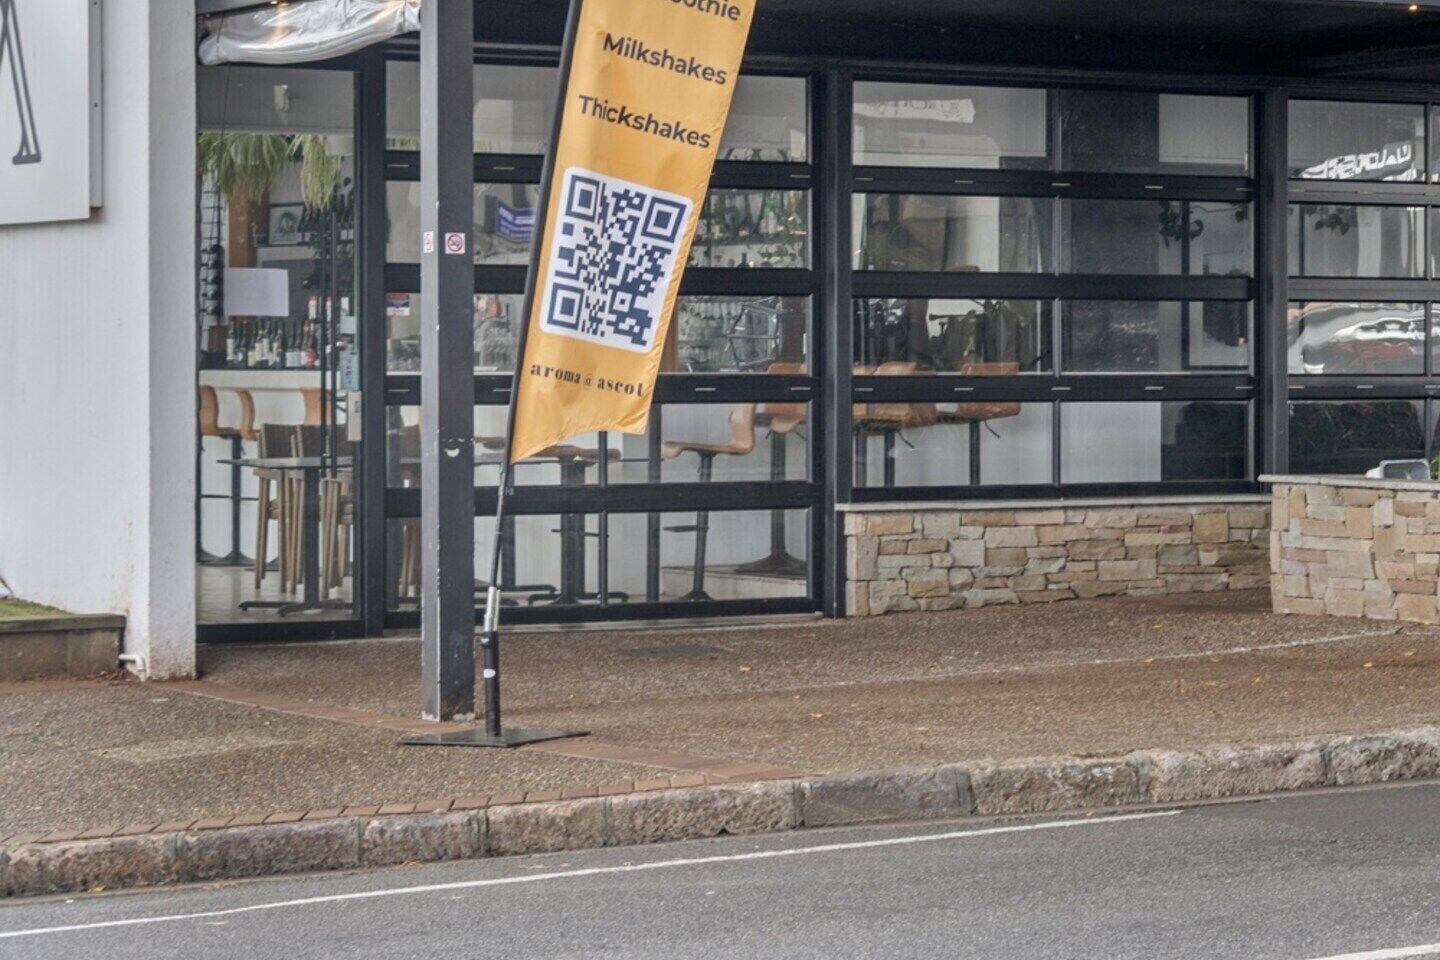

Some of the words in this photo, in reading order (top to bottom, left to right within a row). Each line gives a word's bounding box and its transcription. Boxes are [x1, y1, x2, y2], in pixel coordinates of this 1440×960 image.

[602, 32, 727, 85] Milkshakes
[578, 94, 711, 149] Thickshakes
[530, 363, 581, 384] aroma
[597, 378, 644, 397] ascot
